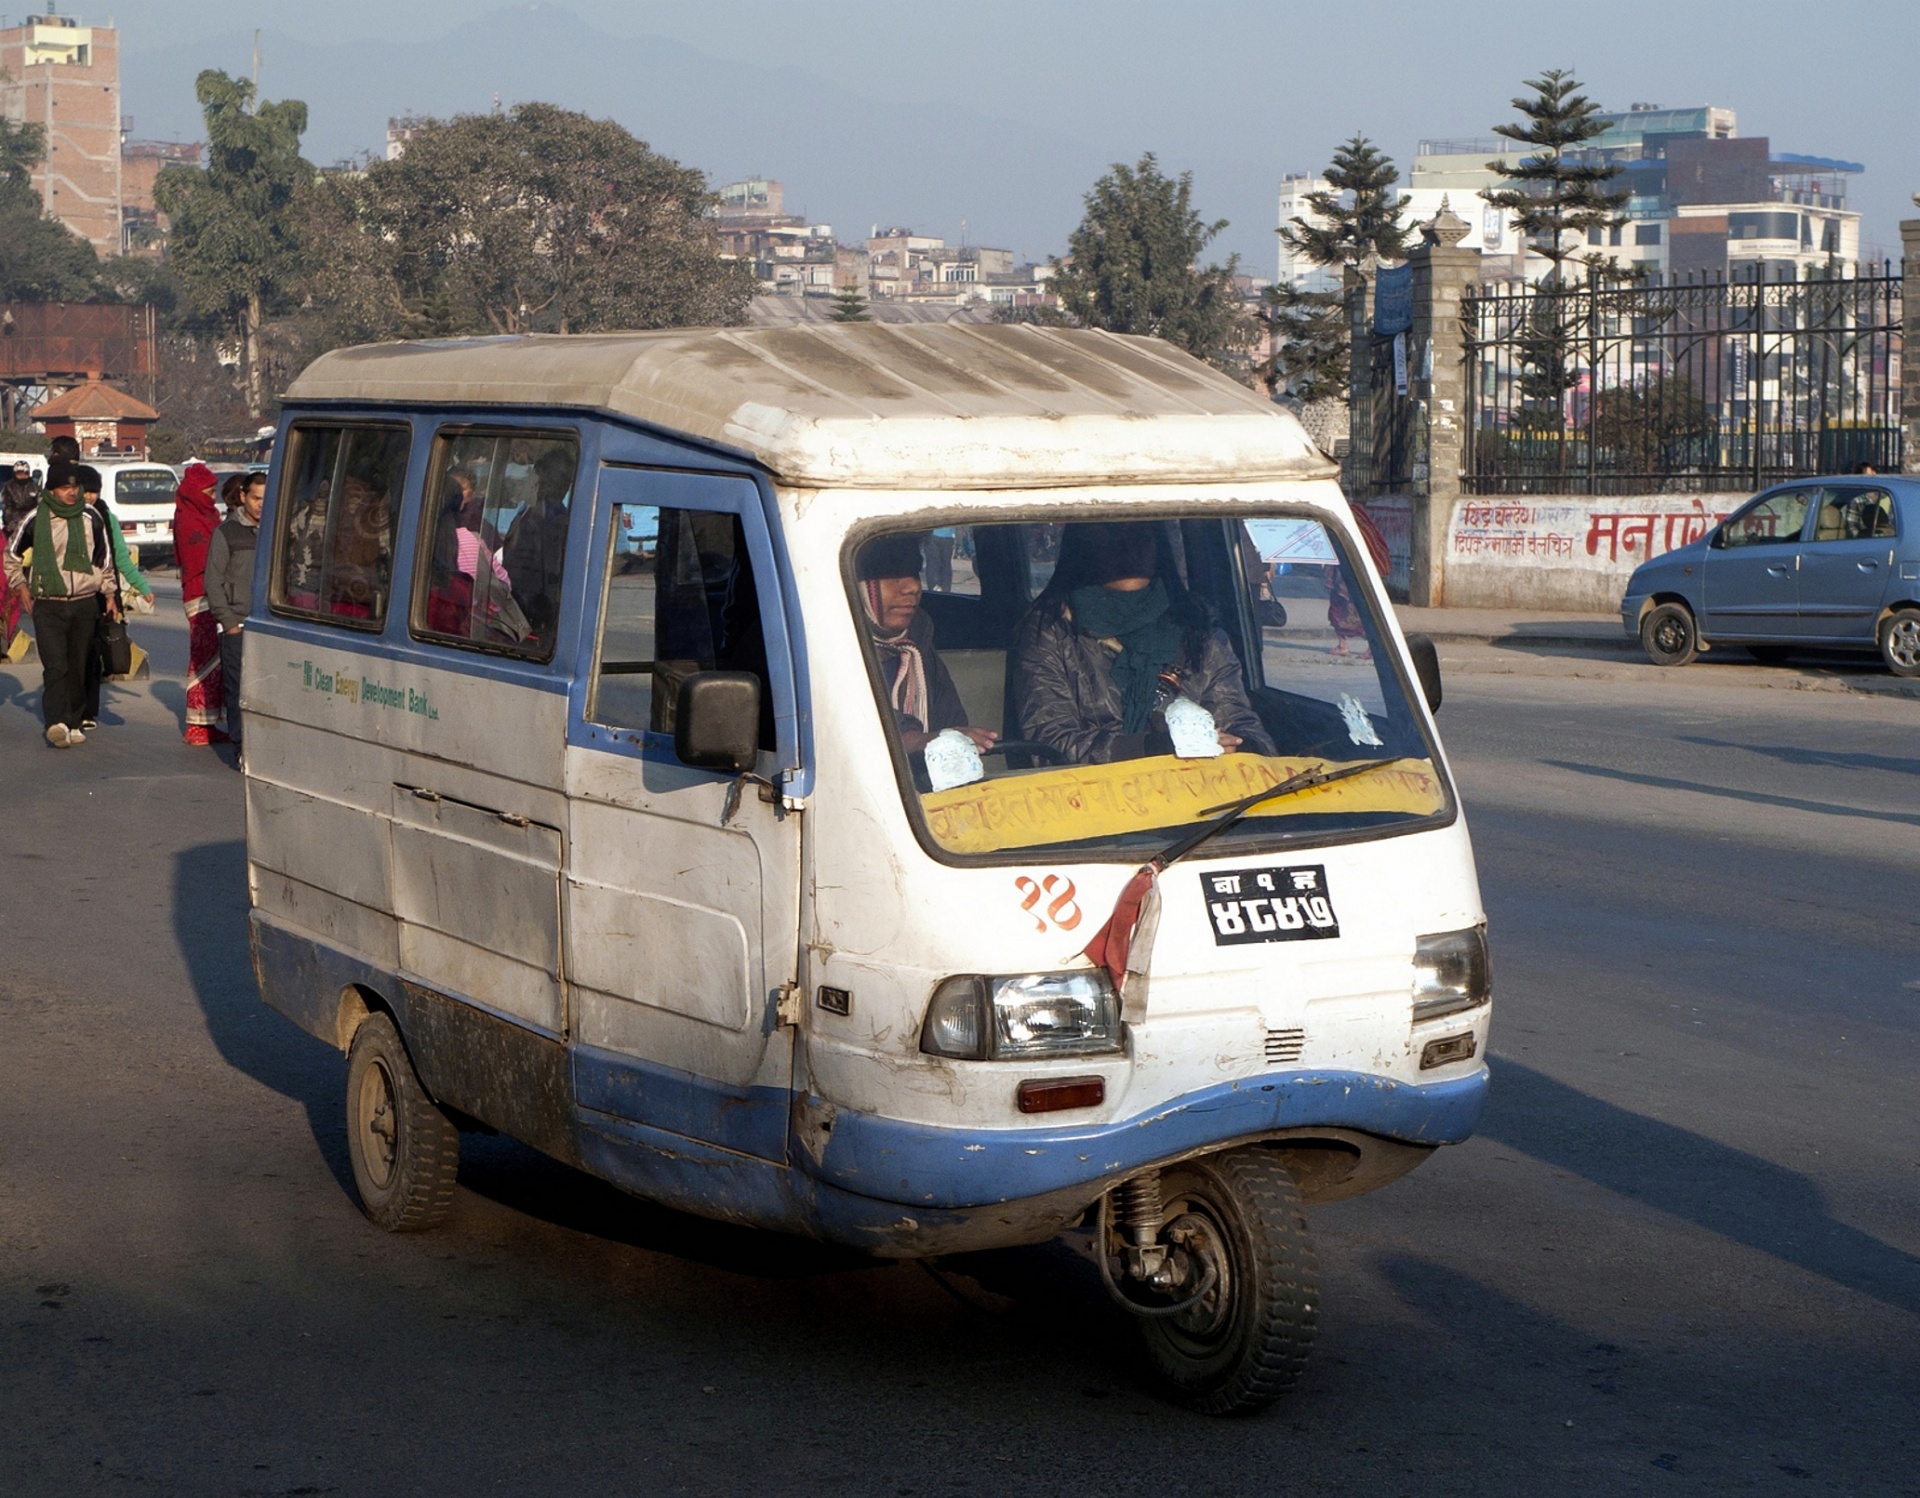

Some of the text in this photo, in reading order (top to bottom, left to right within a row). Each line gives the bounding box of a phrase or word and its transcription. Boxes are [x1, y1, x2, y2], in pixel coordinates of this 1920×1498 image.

[1586, 513, 1661, 563] मन
[315, 667, 333, 693] Clean
[335, 671, 359, 704] Energy
[361, 676, 405, 710] Development
[408, 687, 428, 716] Bank
[1014, 873, 1083, 934] १४
